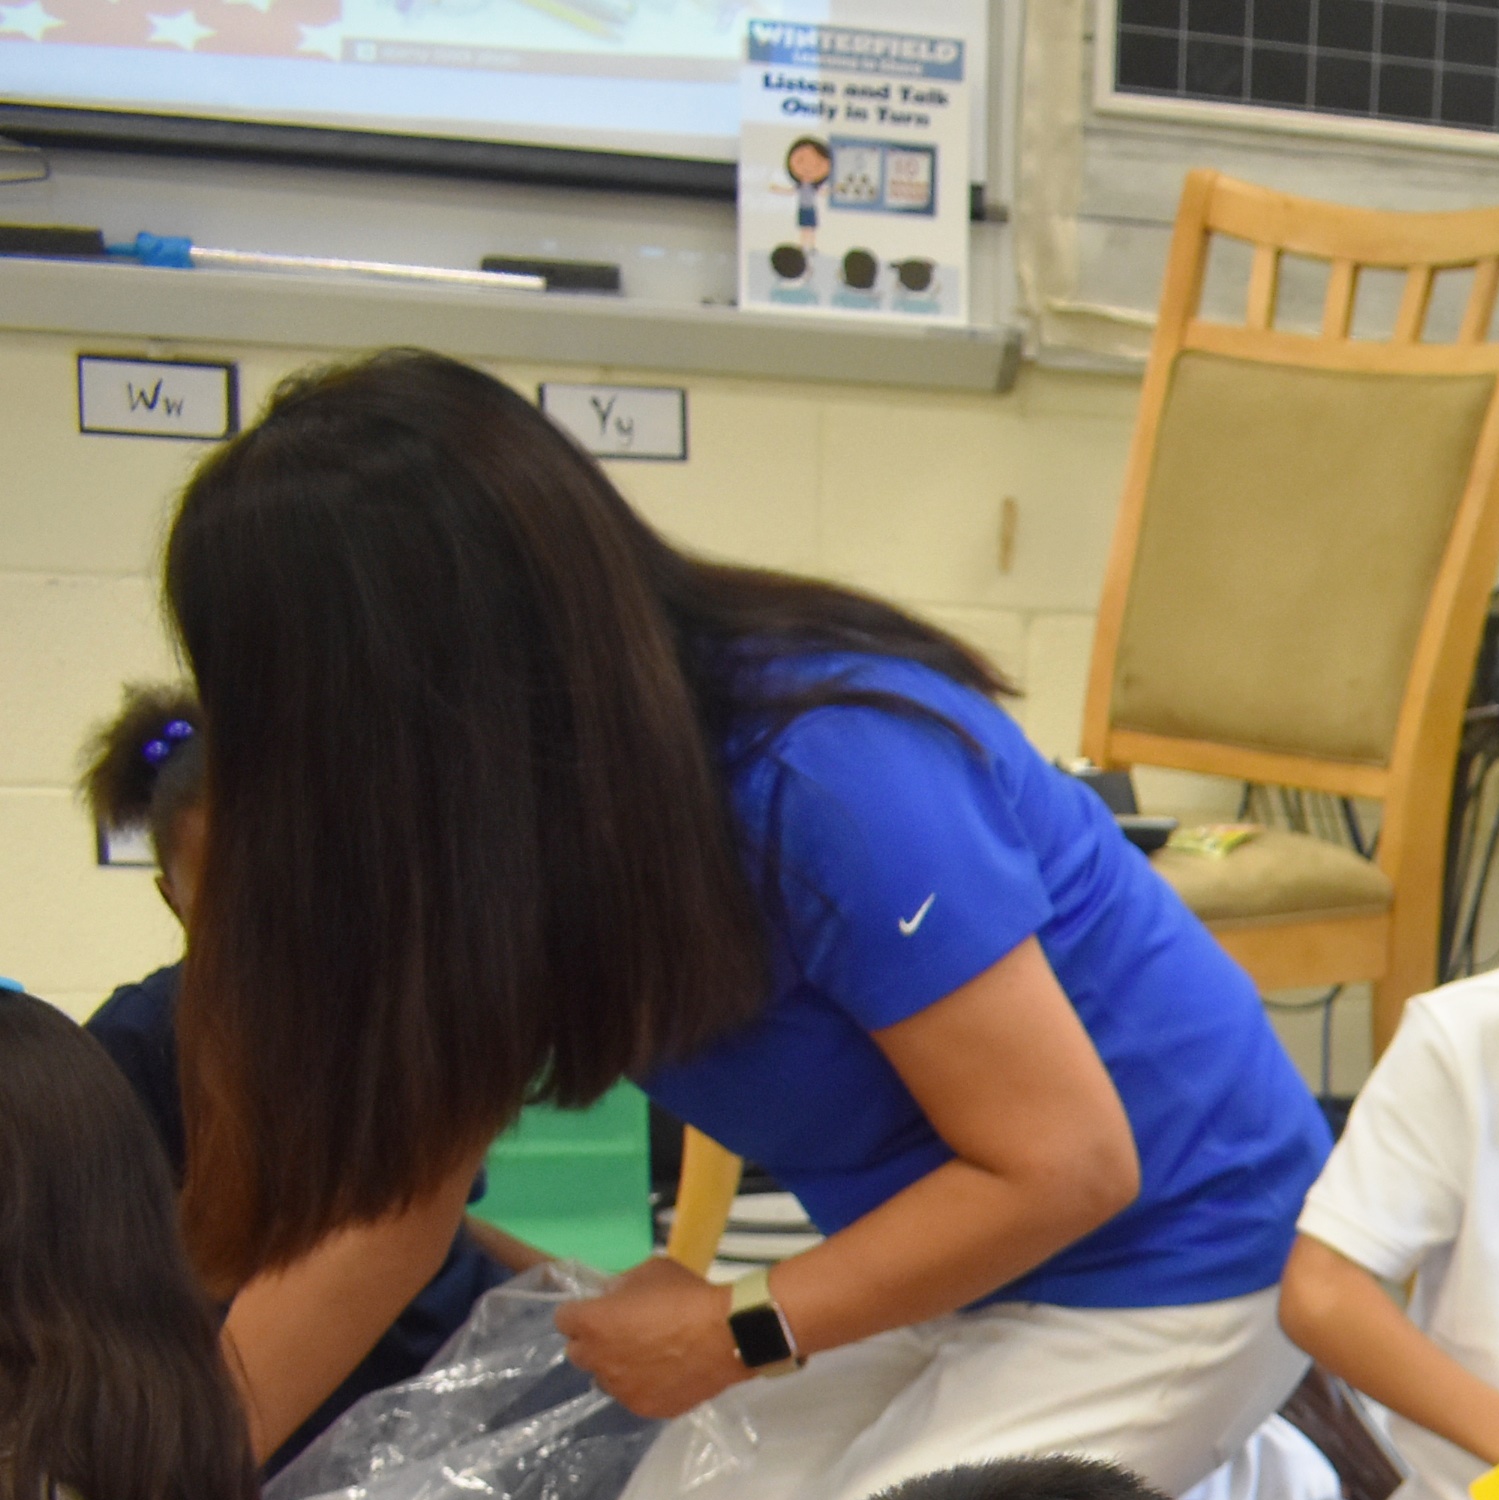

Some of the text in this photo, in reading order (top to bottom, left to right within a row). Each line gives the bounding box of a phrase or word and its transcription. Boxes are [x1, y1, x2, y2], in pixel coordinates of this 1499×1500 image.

[752, 24, 957, 62] WINTERFIELD
[764, 73, 949, 105] Listen and Talk
[782, 97, 929, 126] Only in Turn
